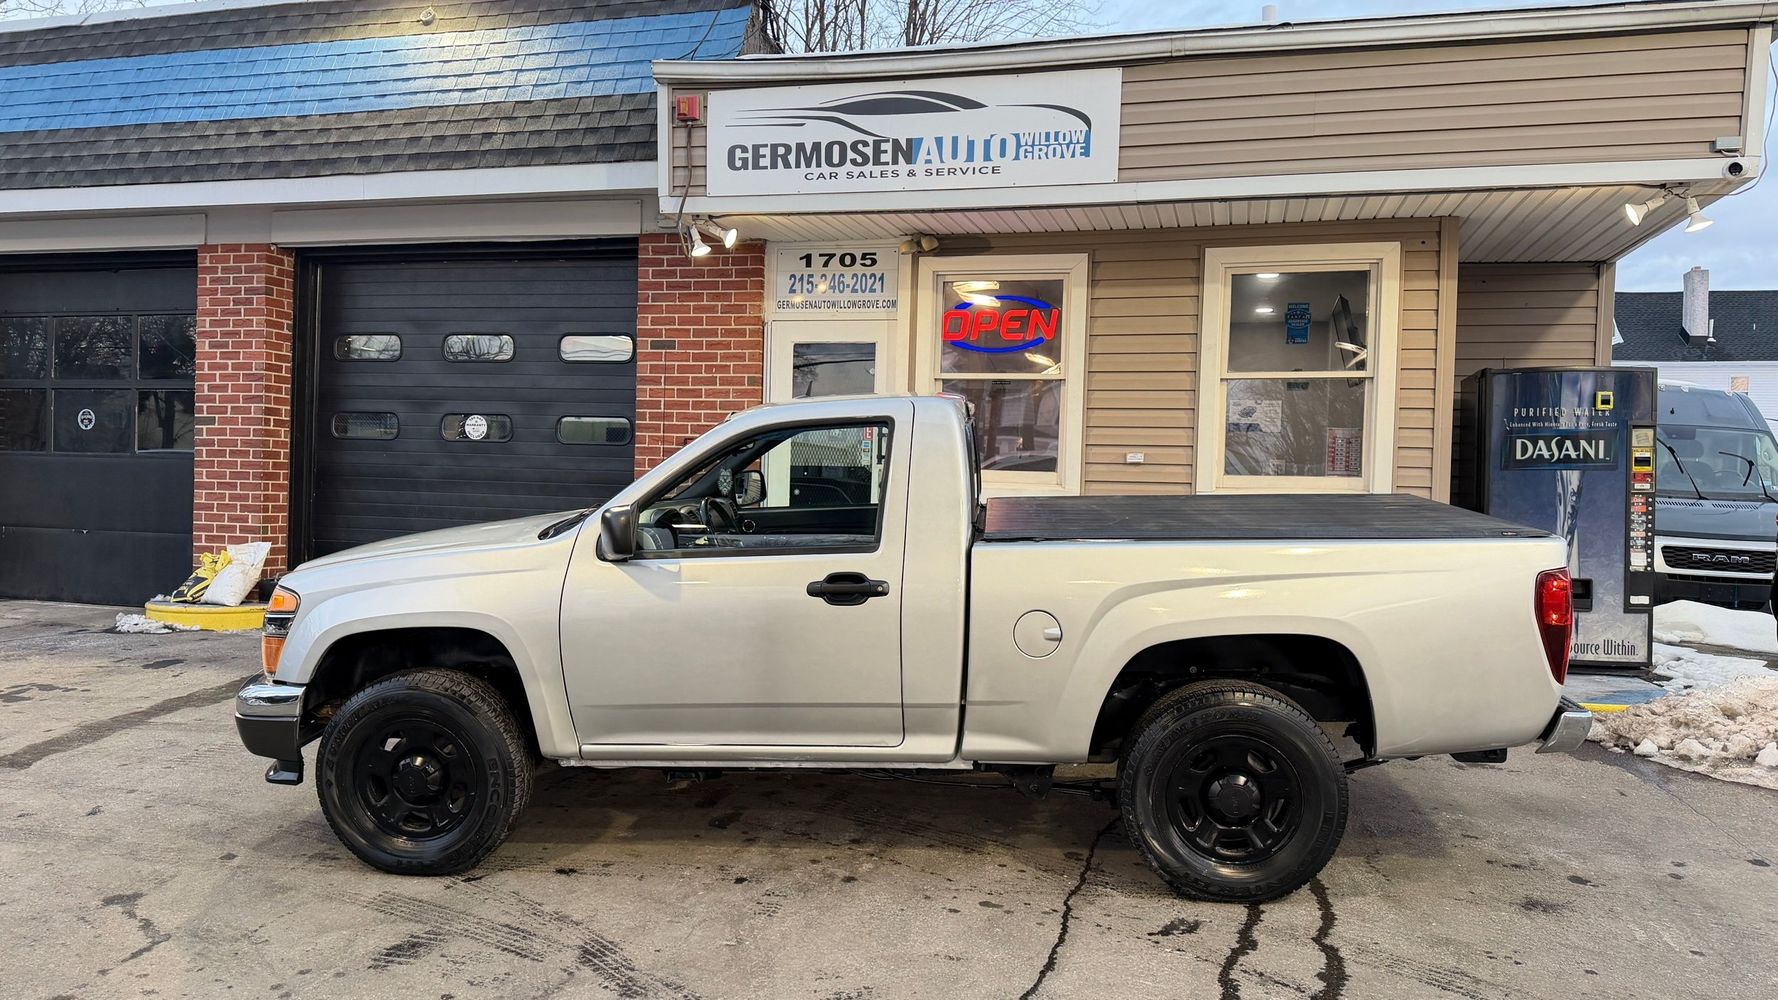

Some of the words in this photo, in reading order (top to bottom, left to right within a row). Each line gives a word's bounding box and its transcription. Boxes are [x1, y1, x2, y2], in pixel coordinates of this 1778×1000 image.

[727, 138, 912, 171] GERMOSEN
[914, 132, 1016, 165] AUTO
[1019, 129, 1086, 146] WILLOW
[1019, 144, 1087, 161] GROVE
[804, 172, 839, 181] CAR
[846, 169, 900, 180] SALES
[906, 168, 917, 178] &
[924, 165, 1001, 177] SERVICE
[799, 252, 878, 269] 1705
[777, 299, 897, 310] GERMOSENAUTOWILLOWGROVE.COM
[943, 308, 1061, 341] OPEN
[1513, 407, 1567, 418] PURIFIED
[1515, 436, 1605, 463] DASANI
[1692, 553, 1750, 564] RAM
[1570, 643, 1600, 655] ource
